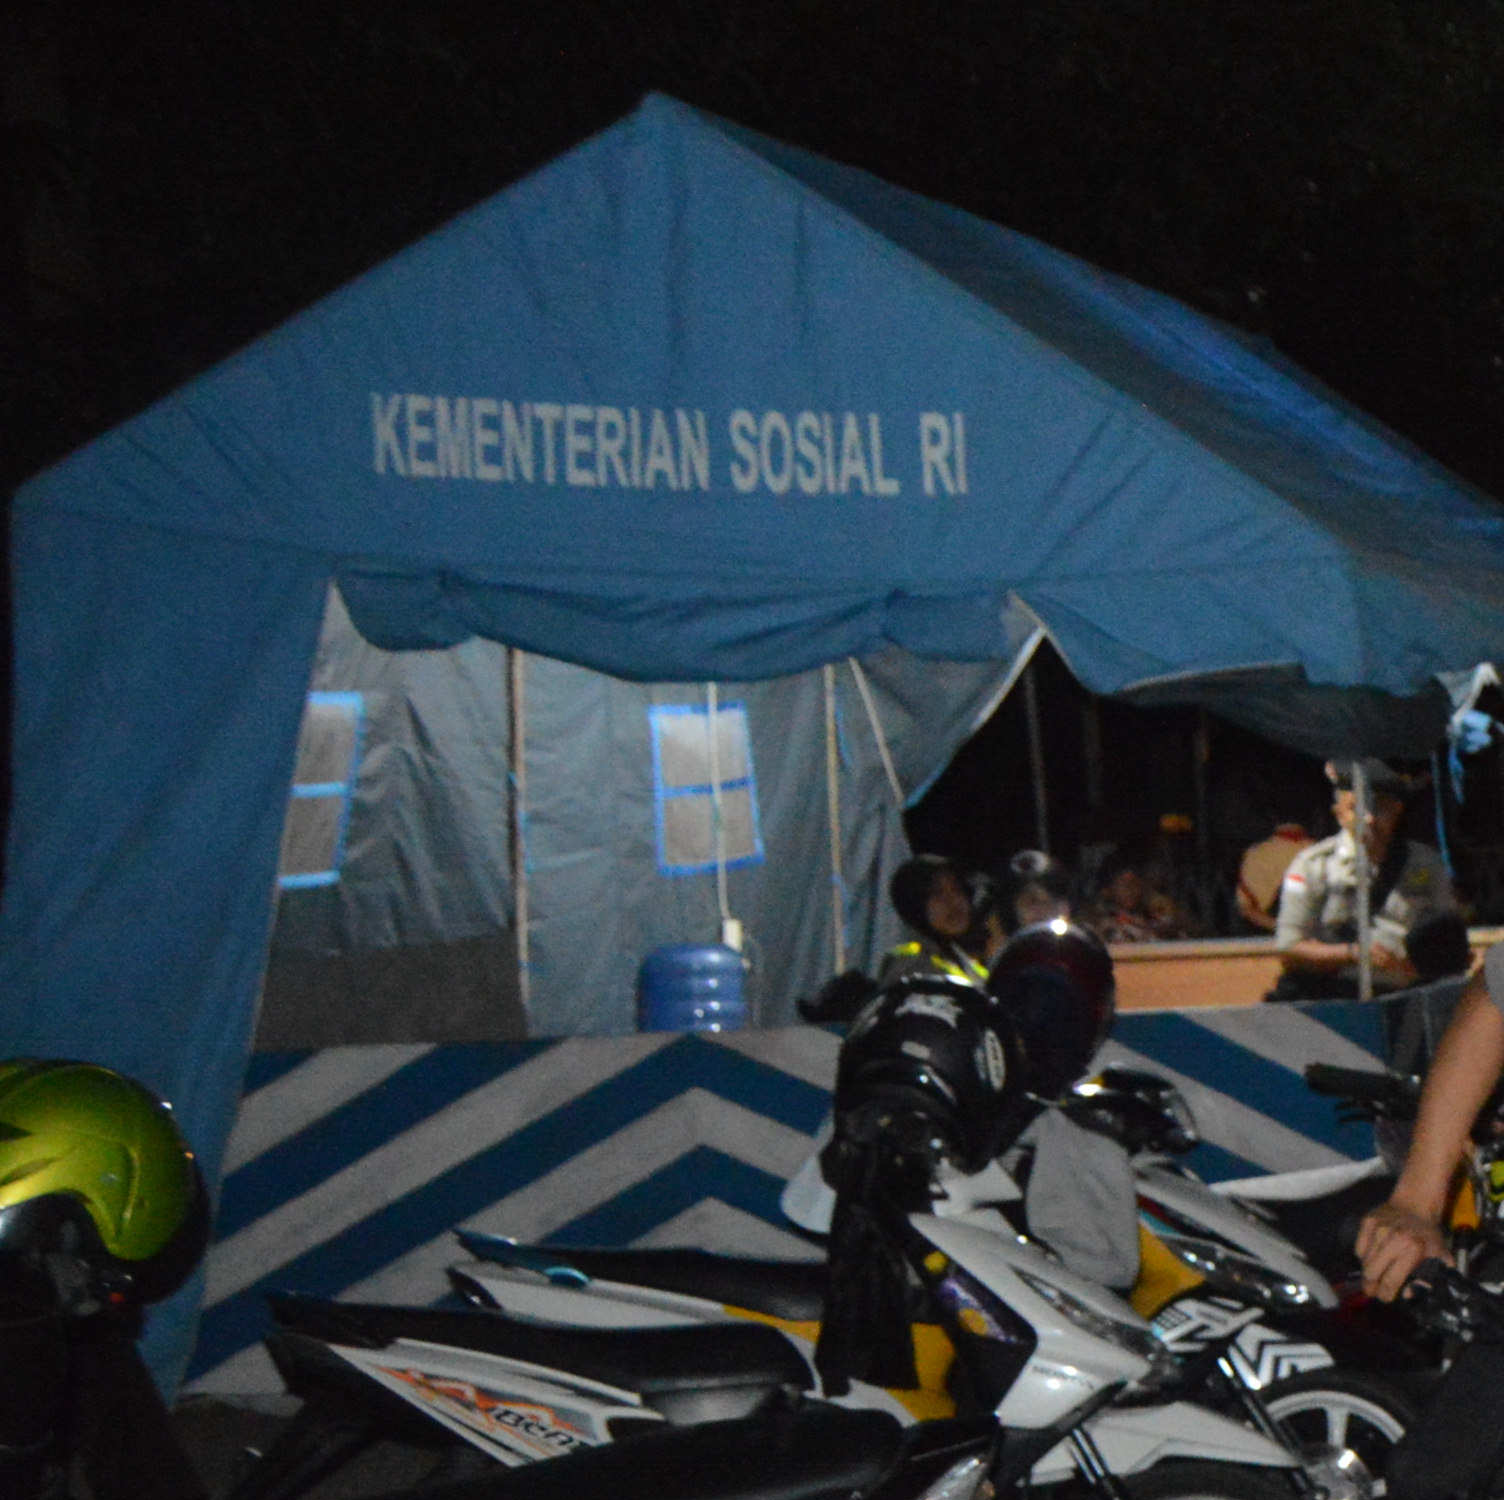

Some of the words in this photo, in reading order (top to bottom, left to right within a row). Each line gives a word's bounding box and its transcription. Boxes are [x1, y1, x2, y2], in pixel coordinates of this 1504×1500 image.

[370, 391, 711, 491] KEMENTERIAN
[728, 408, 900, 496] SOSIAL
[918, 410, 968, 496] RI
